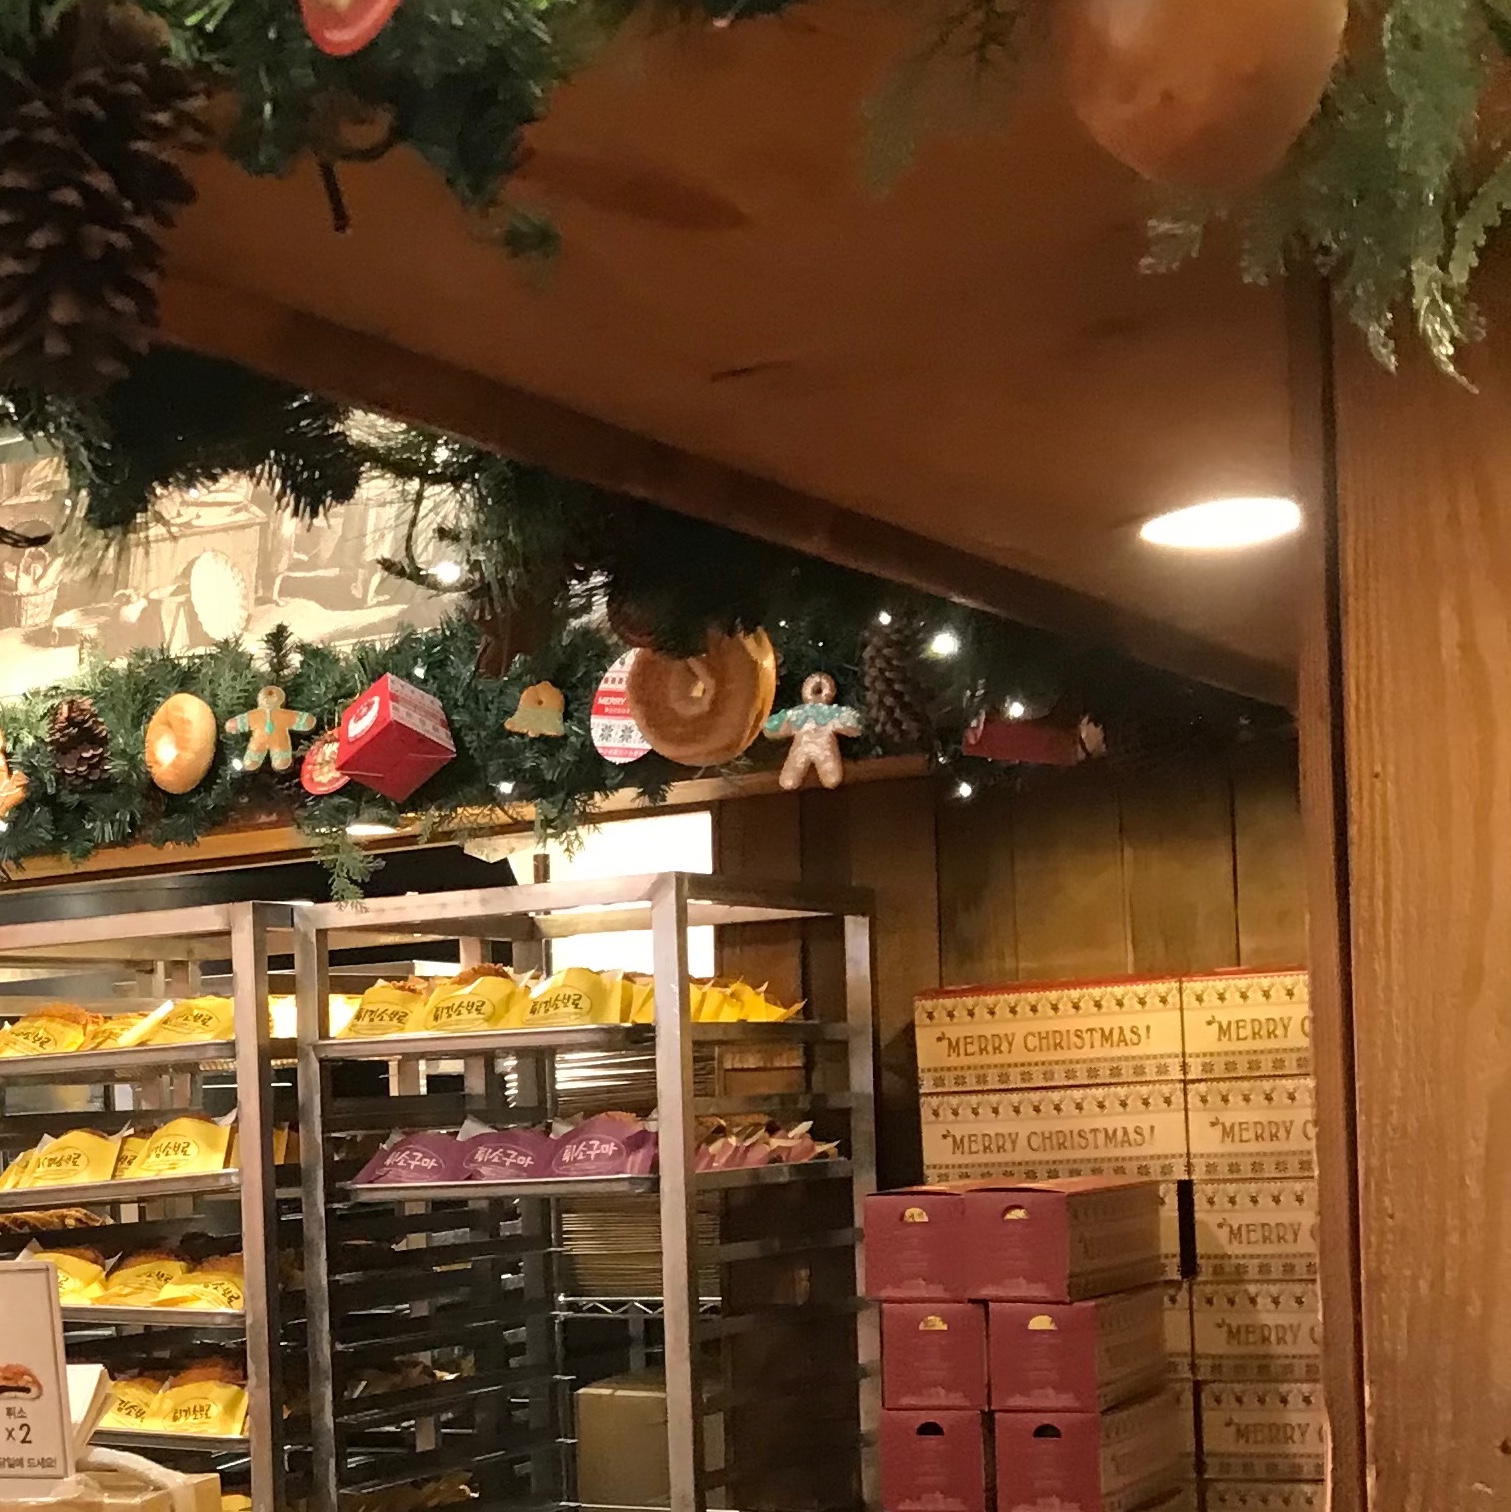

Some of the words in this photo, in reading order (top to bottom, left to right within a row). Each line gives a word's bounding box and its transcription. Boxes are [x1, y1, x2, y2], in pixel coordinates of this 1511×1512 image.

[945, 1032, 1016, 1058] MERRY
[1023, 1023, 1152, 1053] CHRISTMAS!
[1217, 1016, 1293, 1043] MERRY
[950, 1130, 1020, 1156] MERRY
[1027, 1124, 1156, 1152] CHRISTMAS!
[1220, 1118, 1294, 1144] MERRY
[1227, 1221, 1302, 1246] MERRY
[1224, 1321, 1303, 1347] MERRY
[1233, 1421, 1311, 1447] MERRY
